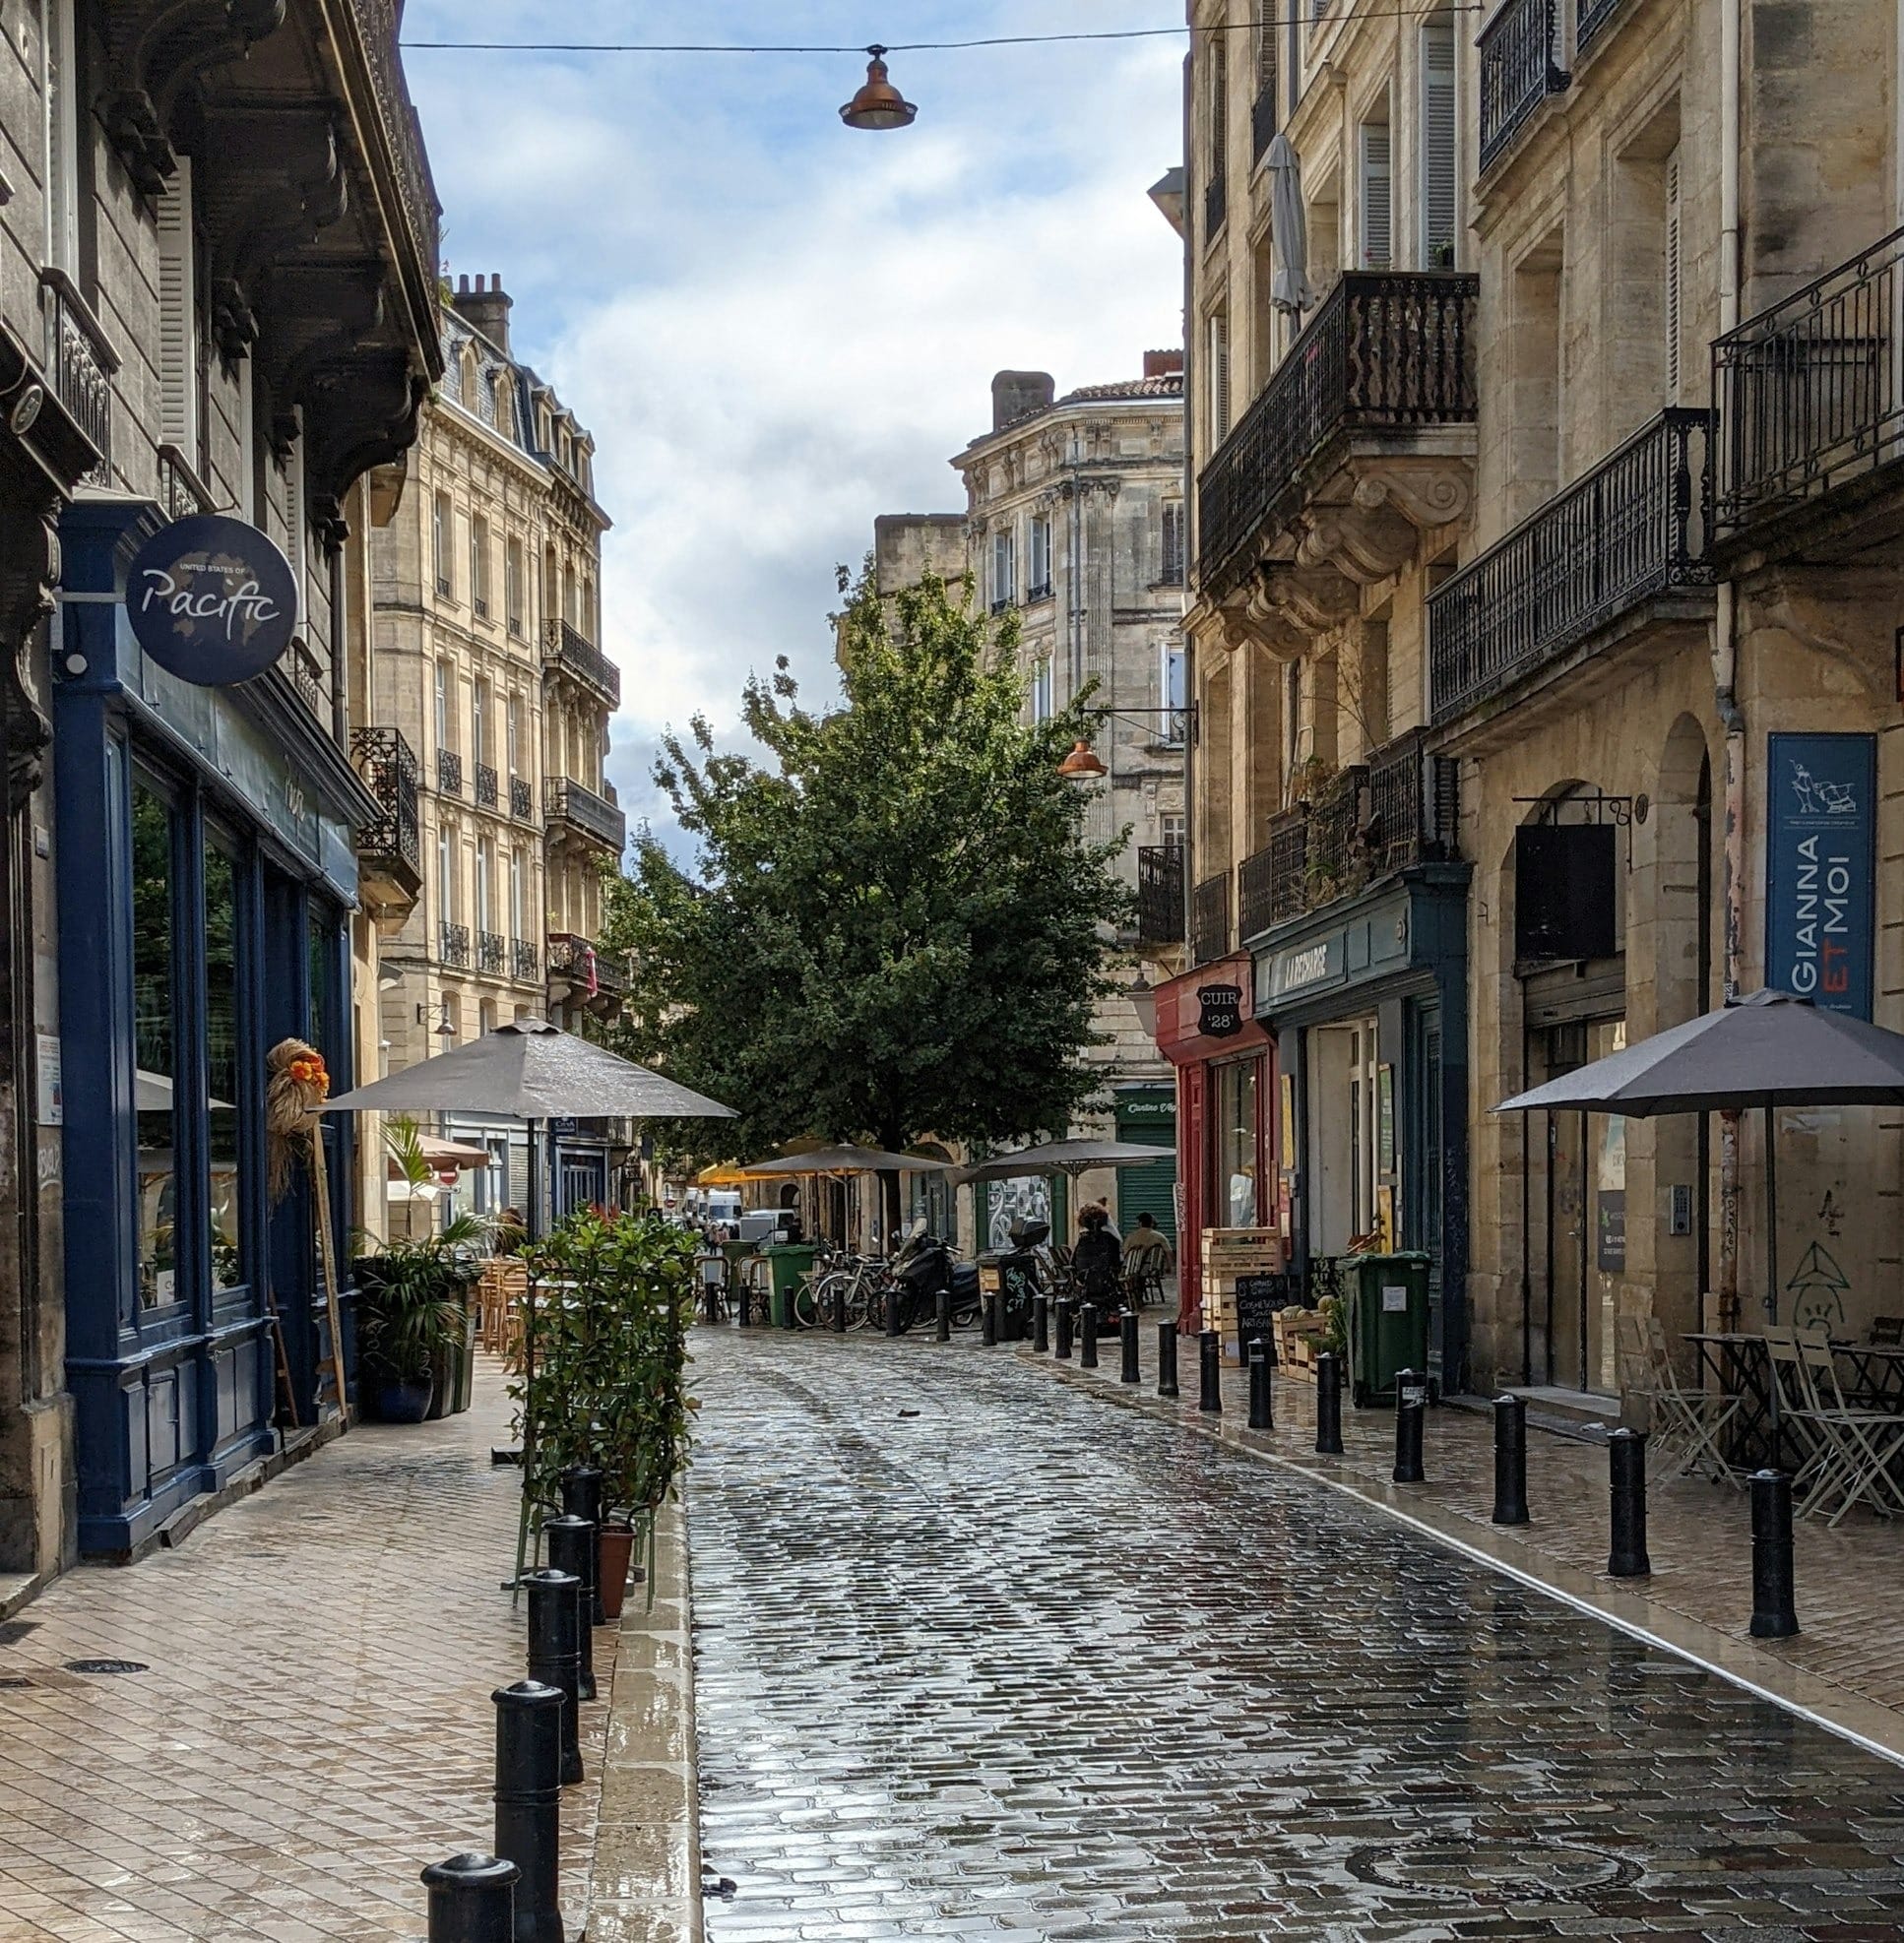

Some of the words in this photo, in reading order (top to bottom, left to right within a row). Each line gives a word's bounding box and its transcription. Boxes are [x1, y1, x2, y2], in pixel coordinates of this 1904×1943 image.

[179, 563, 206, 572] UNITED
[207, 565, 233, 574] STATES
[142, 569, 281, 640] Pacific
[1791, 835, 1819, 993] GIANNA
[1823, 856, 1850, 933] MOI
[1823, 937, 1849, 992] ET
[1201, 991, 1238, 1005] CUIR
